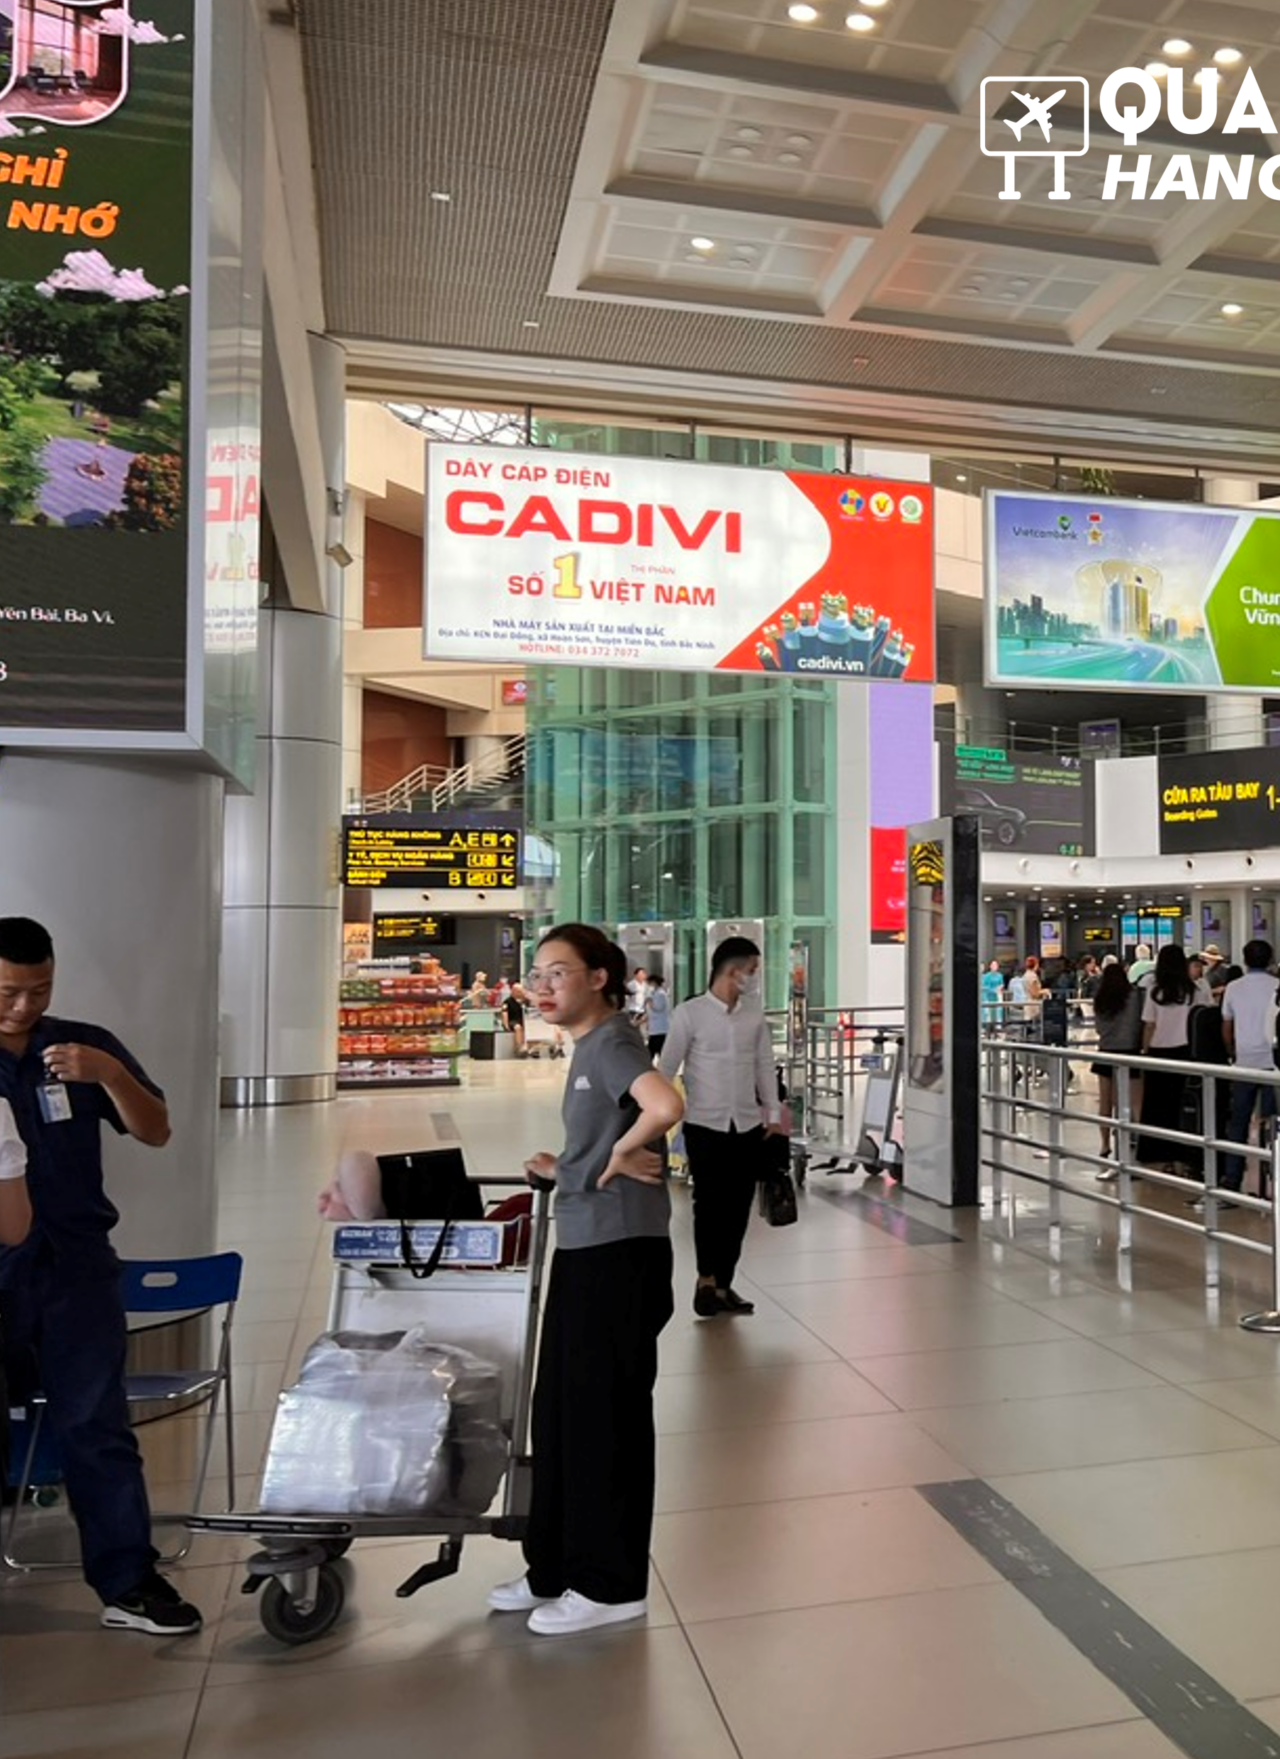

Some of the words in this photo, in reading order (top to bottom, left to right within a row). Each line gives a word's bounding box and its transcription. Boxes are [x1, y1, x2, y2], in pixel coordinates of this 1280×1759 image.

[7, 200, 120, 238] NHỚ
[446, 457, 493, 478] DÂY
[501, 460, 547, 482] CÁP
[555, 466, 610, 490] ĐIỆN
[445, 490, 742, 553] CADIVI
[1012, 526, 1078, 540] Vietcombank
[508, 571, 545, 596] SỐ
[553, 552, 582, 599] 1
[590, 578, 645, 605] VIỆT
[654, 584, 715, 607] NAM
[797, 654, 864, 672] cadivi.vn
[1163, 784, 1188, 805] CỬA
[1190, 787, 1208, 803] RA
[1208, 780, 1233, 800] TÀU
[1235, 782, 1260, 799] BAY
